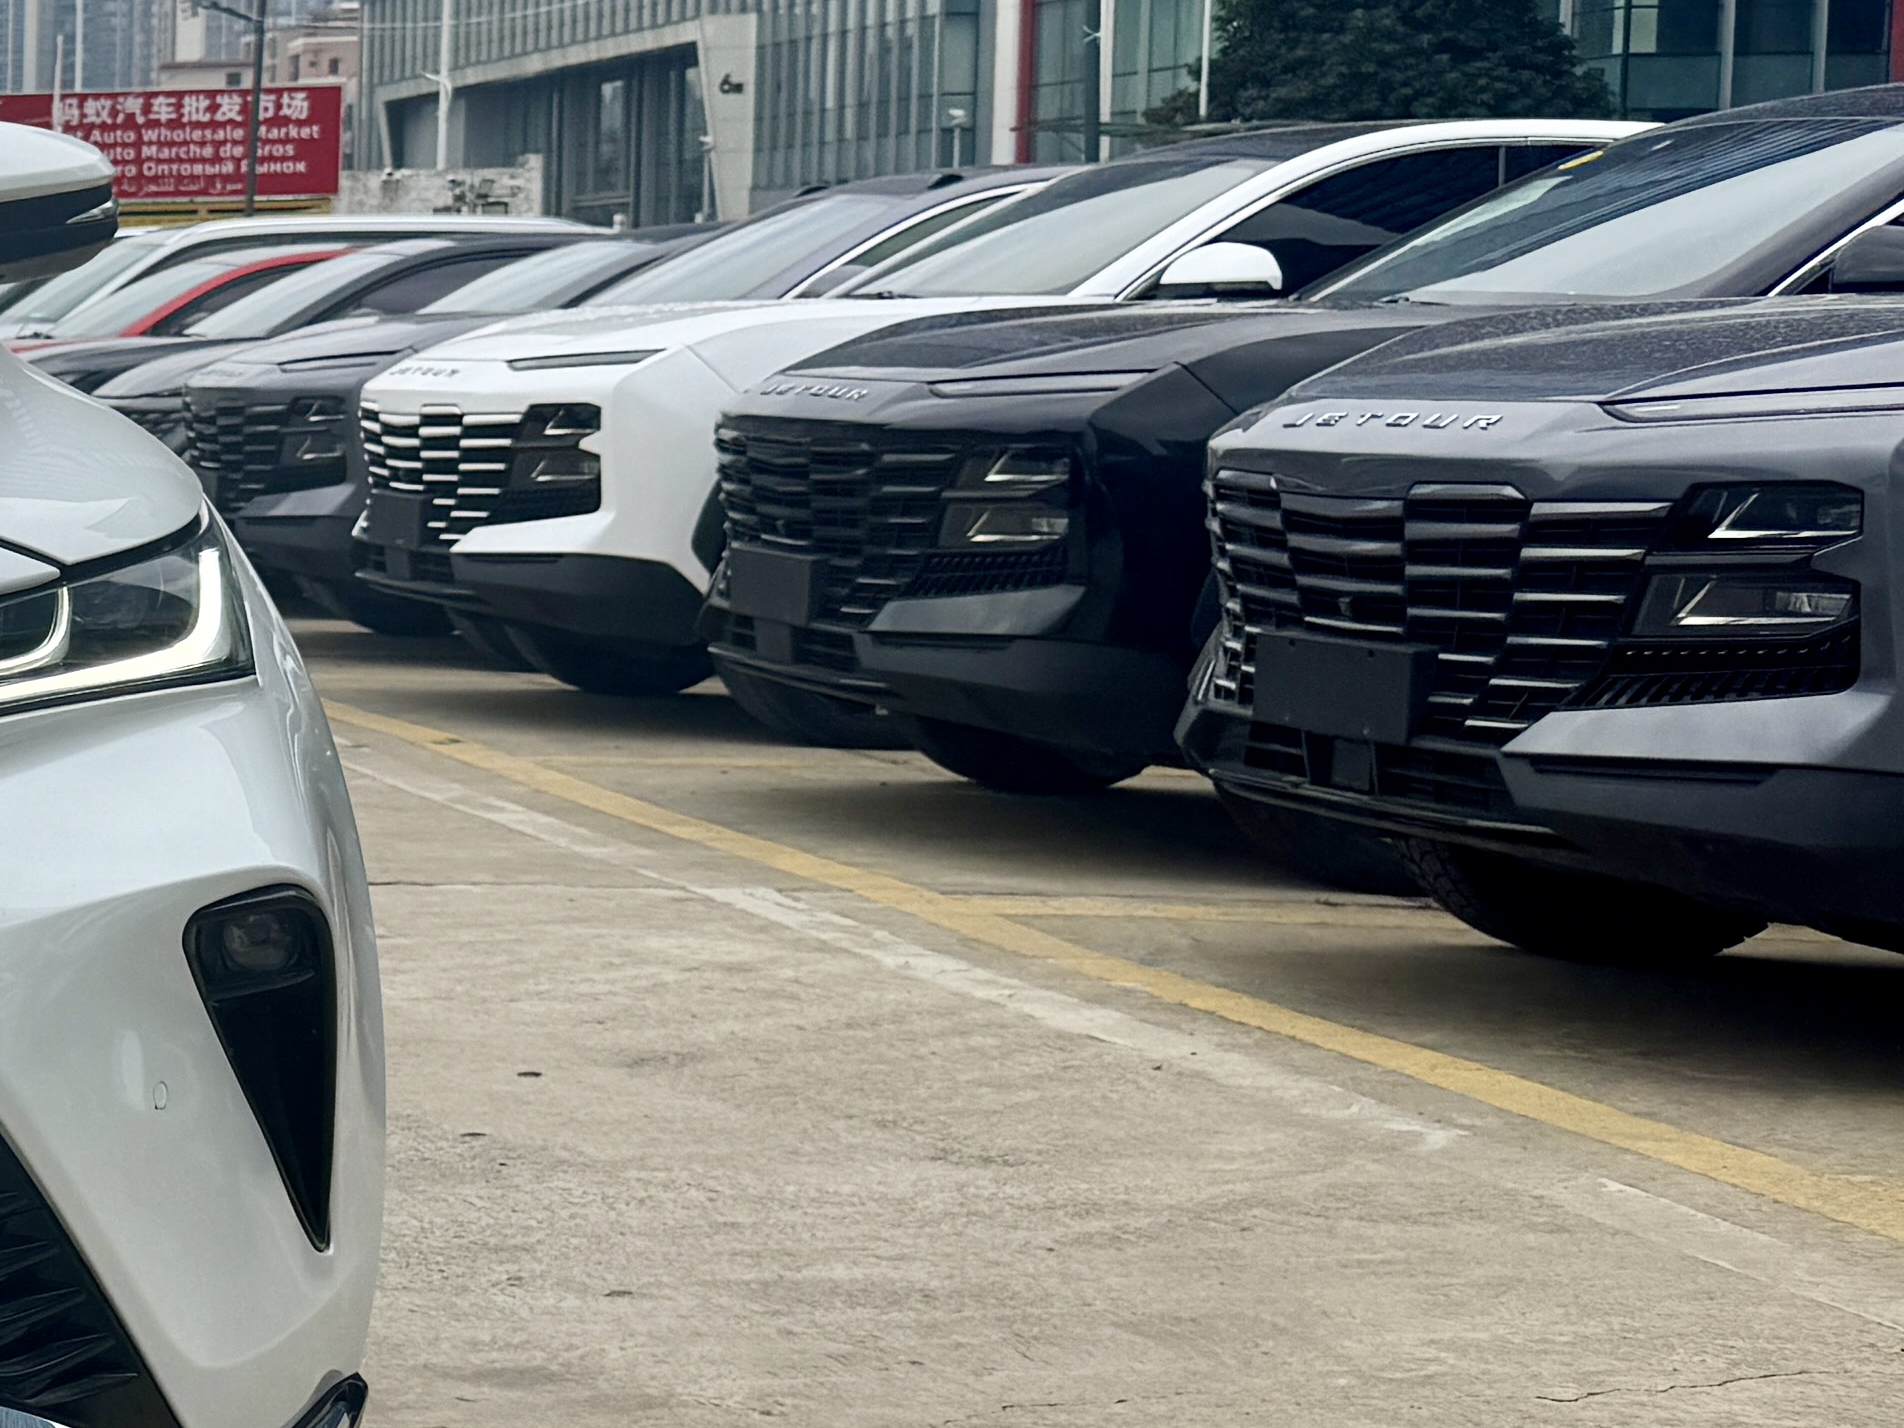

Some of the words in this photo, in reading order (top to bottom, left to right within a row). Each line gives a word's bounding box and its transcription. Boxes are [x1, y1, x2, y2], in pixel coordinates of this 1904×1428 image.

[89, 129, 135, 144] Auto
[141, 125, 244, 143] Wholesale
[103, 146, 136, 160] uto
[141, 142, 214, 160] Marché
[219, 142, 245, 158] de
[142, 159, 234, 176] Оптовый
[1282, 412, 1504, 430] JETOUR
